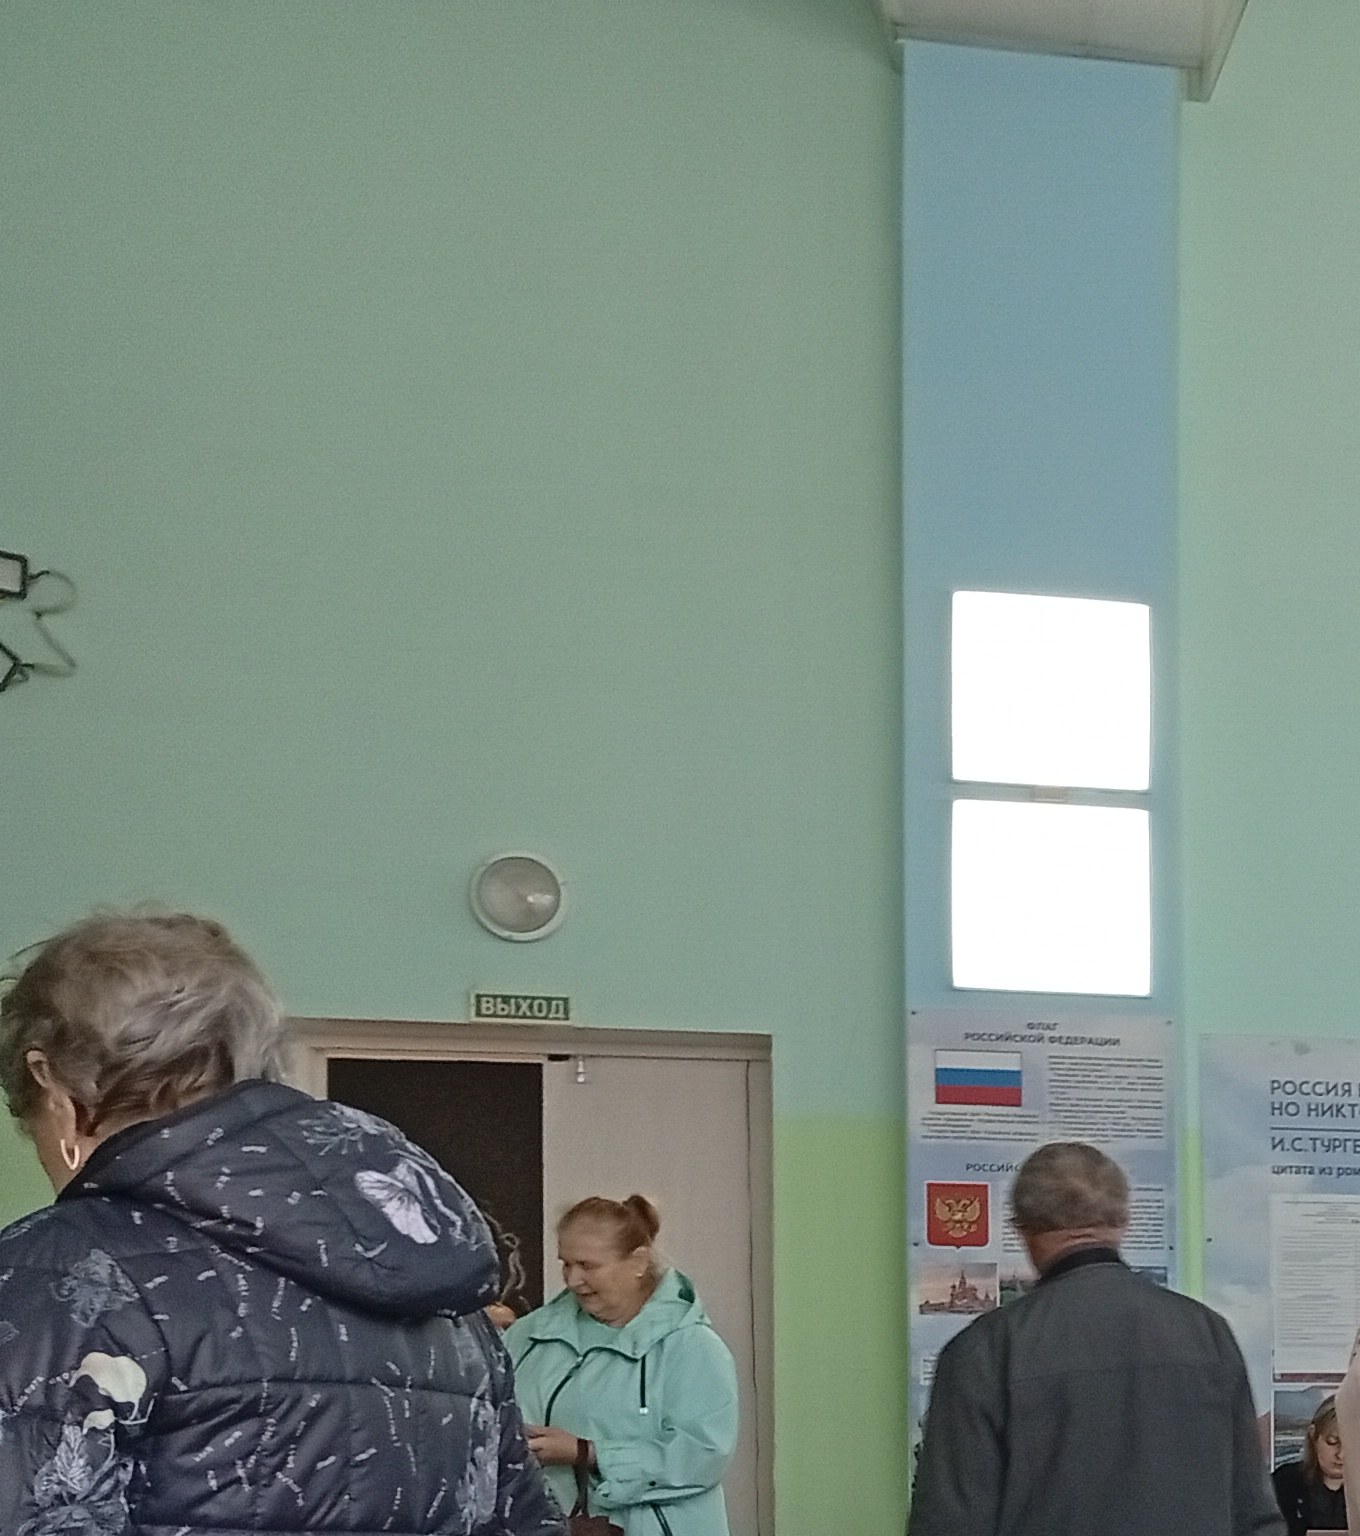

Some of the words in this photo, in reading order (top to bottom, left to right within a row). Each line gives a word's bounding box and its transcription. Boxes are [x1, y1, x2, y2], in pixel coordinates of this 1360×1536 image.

[480, 997, 567, 1019] ВЫХОД
[1027, 1021, 1059, 1032] ФЛАГ
[964, 1031, 1045, 1044] РОССИЙСКОЙ
[1048, 1034, 1121, 1046] ФЕДЕРАЦИИ
[1270, 1080, 1352, 1097] РОССИЯ
[1270, 1101, 1300, 1117] НО
[965, 1163, 1021, 1173] РОССИЙС
[1271, 1165, 1315, 1177] цитата
[1318, 1166, 1333, 1176] из
